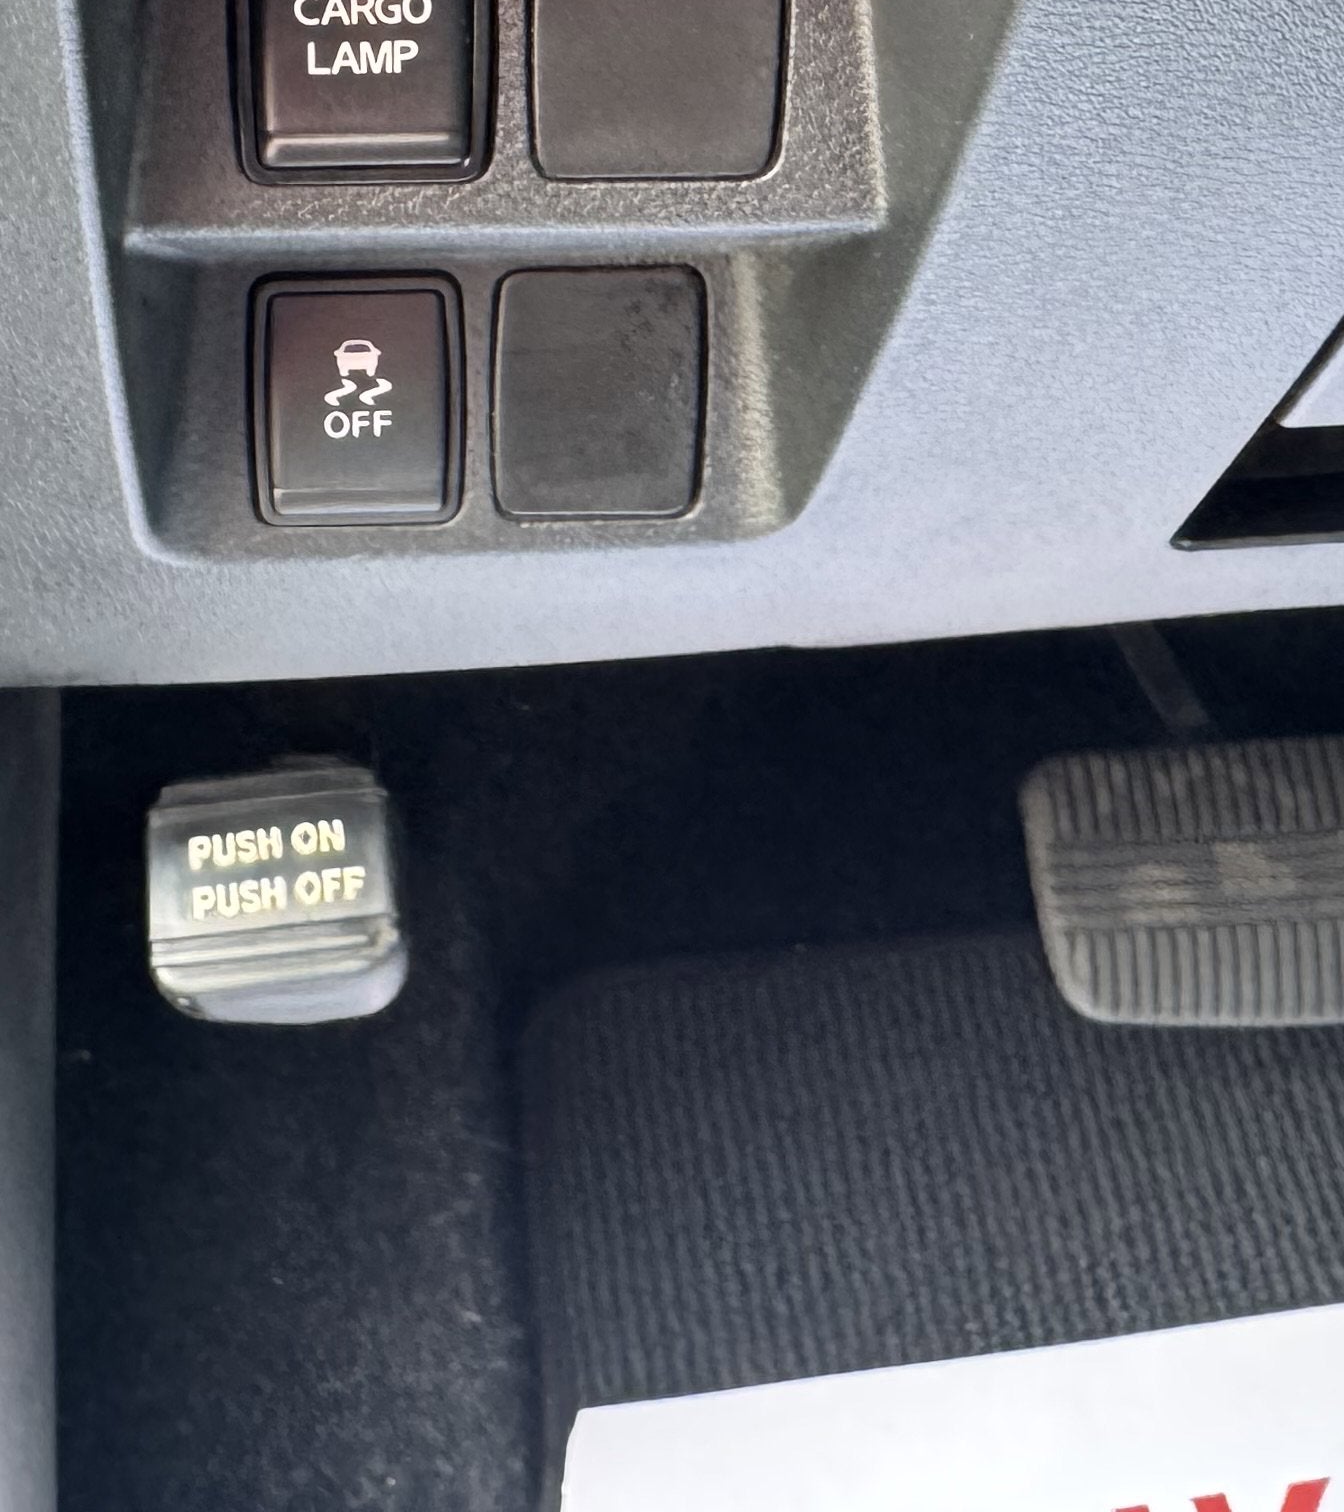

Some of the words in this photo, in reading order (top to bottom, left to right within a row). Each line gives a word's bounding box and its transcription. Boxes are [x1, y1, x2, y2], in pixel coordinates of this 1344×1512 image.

[306, 39, 419, 76] LAMP
[323, 409, 393, 439] OFF
[187, 826, 284, 872] PUSH
[290, 818, 346, 856] ON
[192, 875, 288, 921] PUSH
[293, 865, 366, 905] OFF
